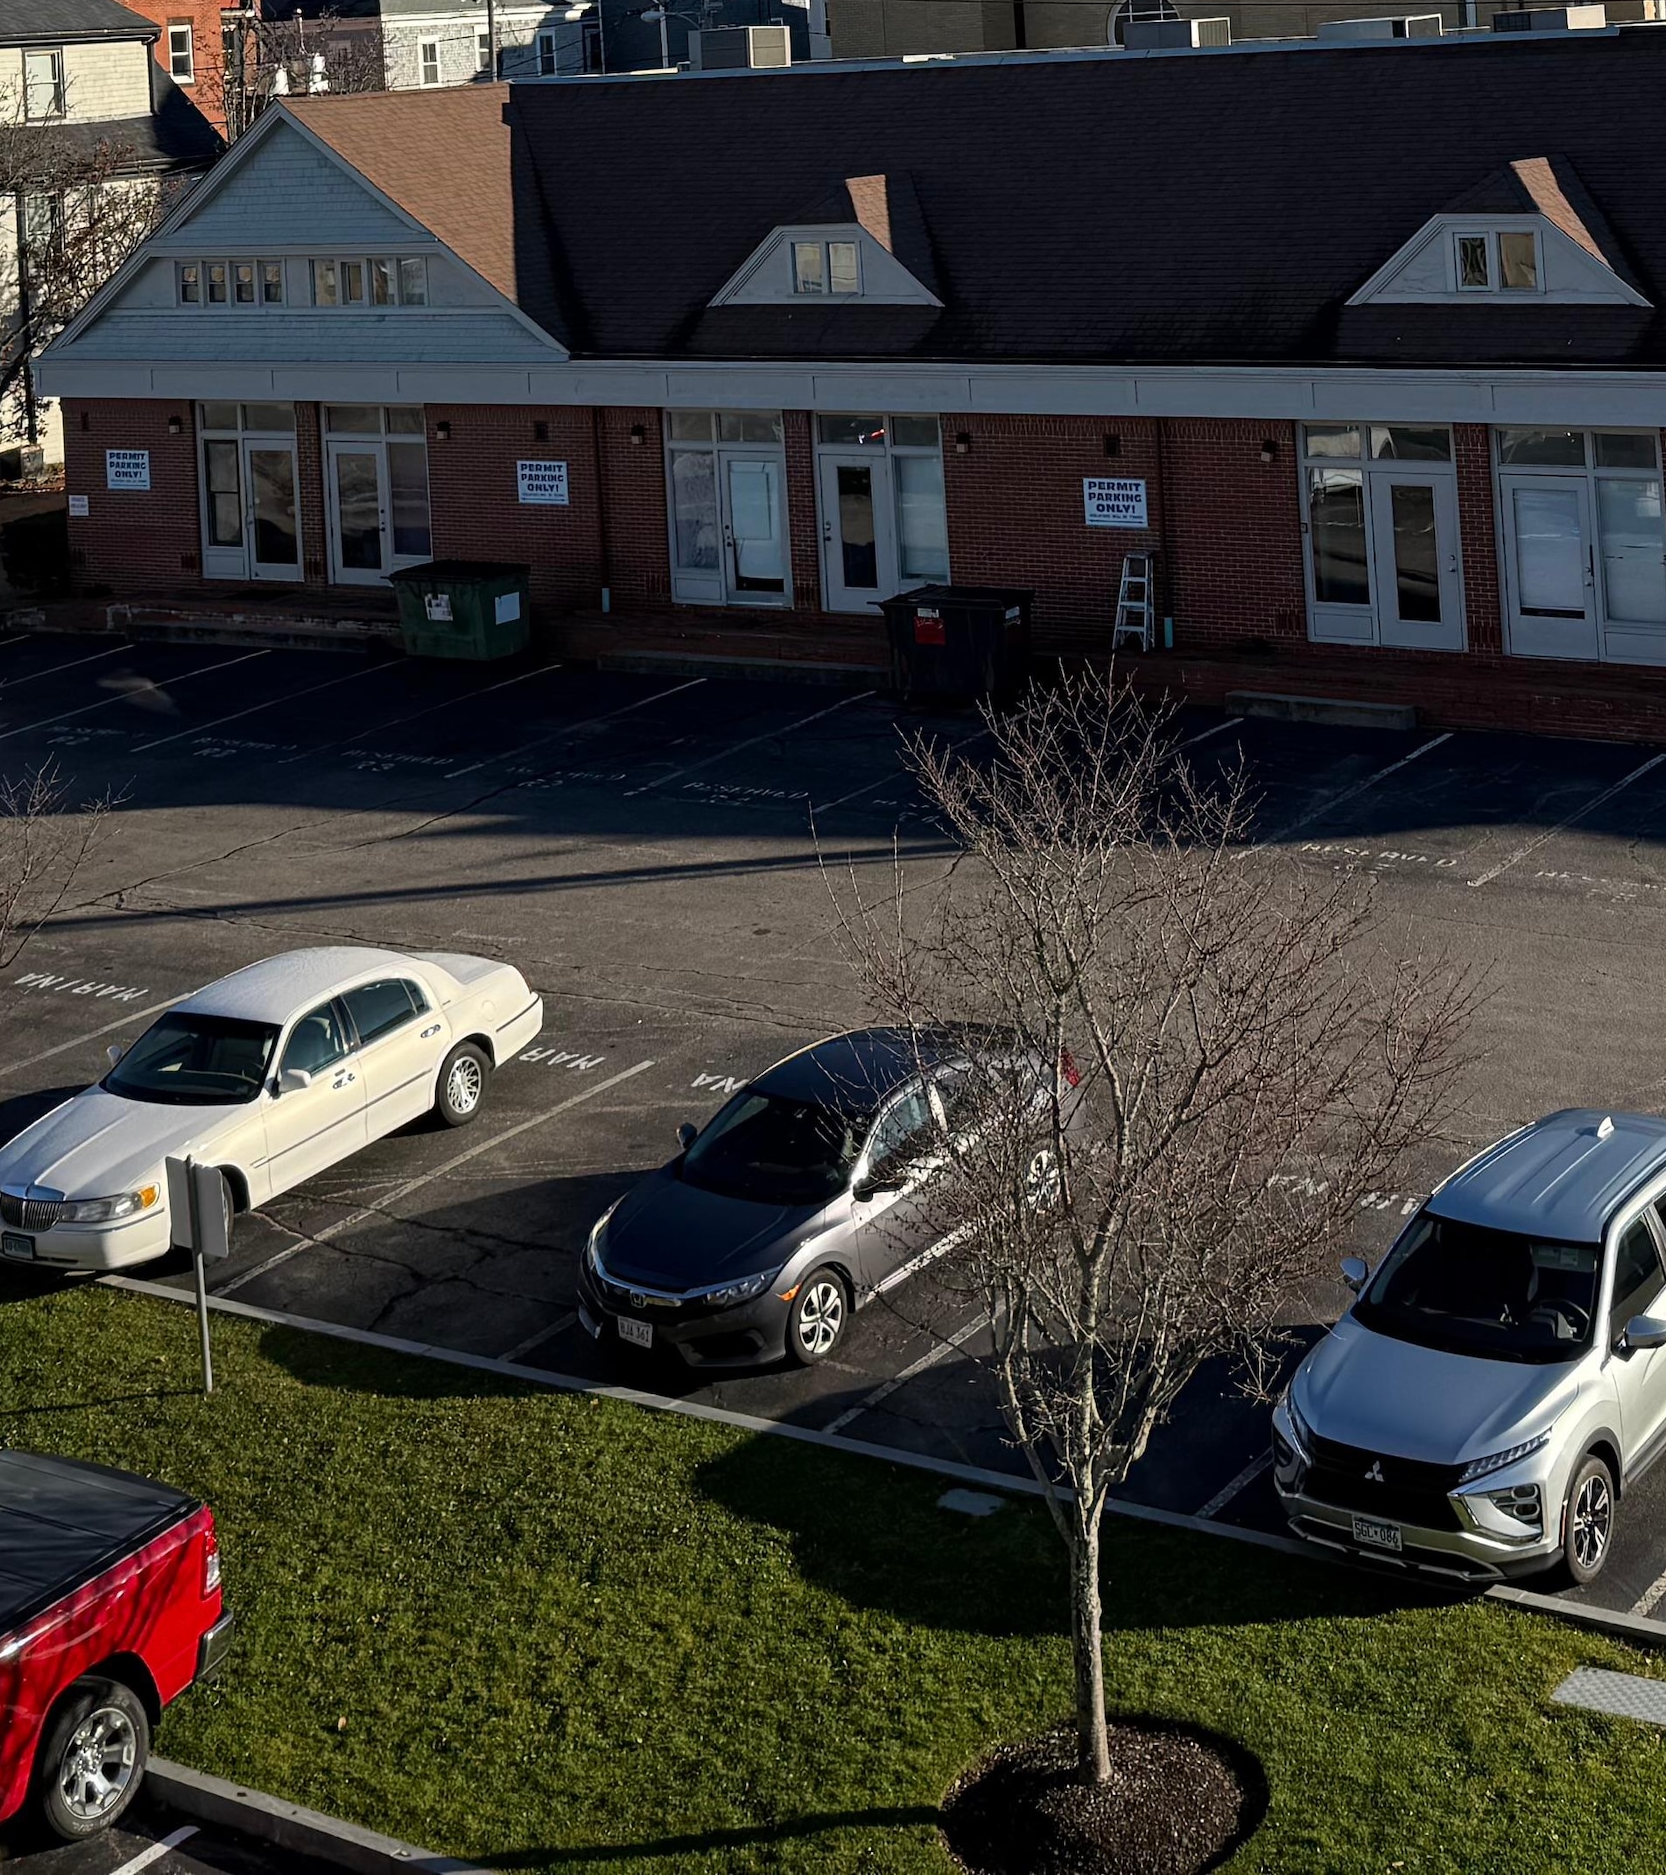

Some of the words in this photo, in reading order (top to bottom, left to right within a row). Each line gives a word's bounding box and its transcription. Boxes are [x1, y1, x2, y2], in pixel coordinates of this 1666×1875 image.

[109, 452, 146, 460] PERMIT
[109, 461, 147, 470] PARKING
[520, 463, 563, 472] PERMIT
[521, 473, 564, 482] PARKING
[527, 483, 559, 492] ONLY!
[1088, 481, 1141, 491] PERMIT
[1088, 492, 1142, 503] PARKING
[1096, 503, 1136, 514] ONLY!
[15, 972, 148, 1001] MARINA
[518, 1046, 606, 1070] MAR
